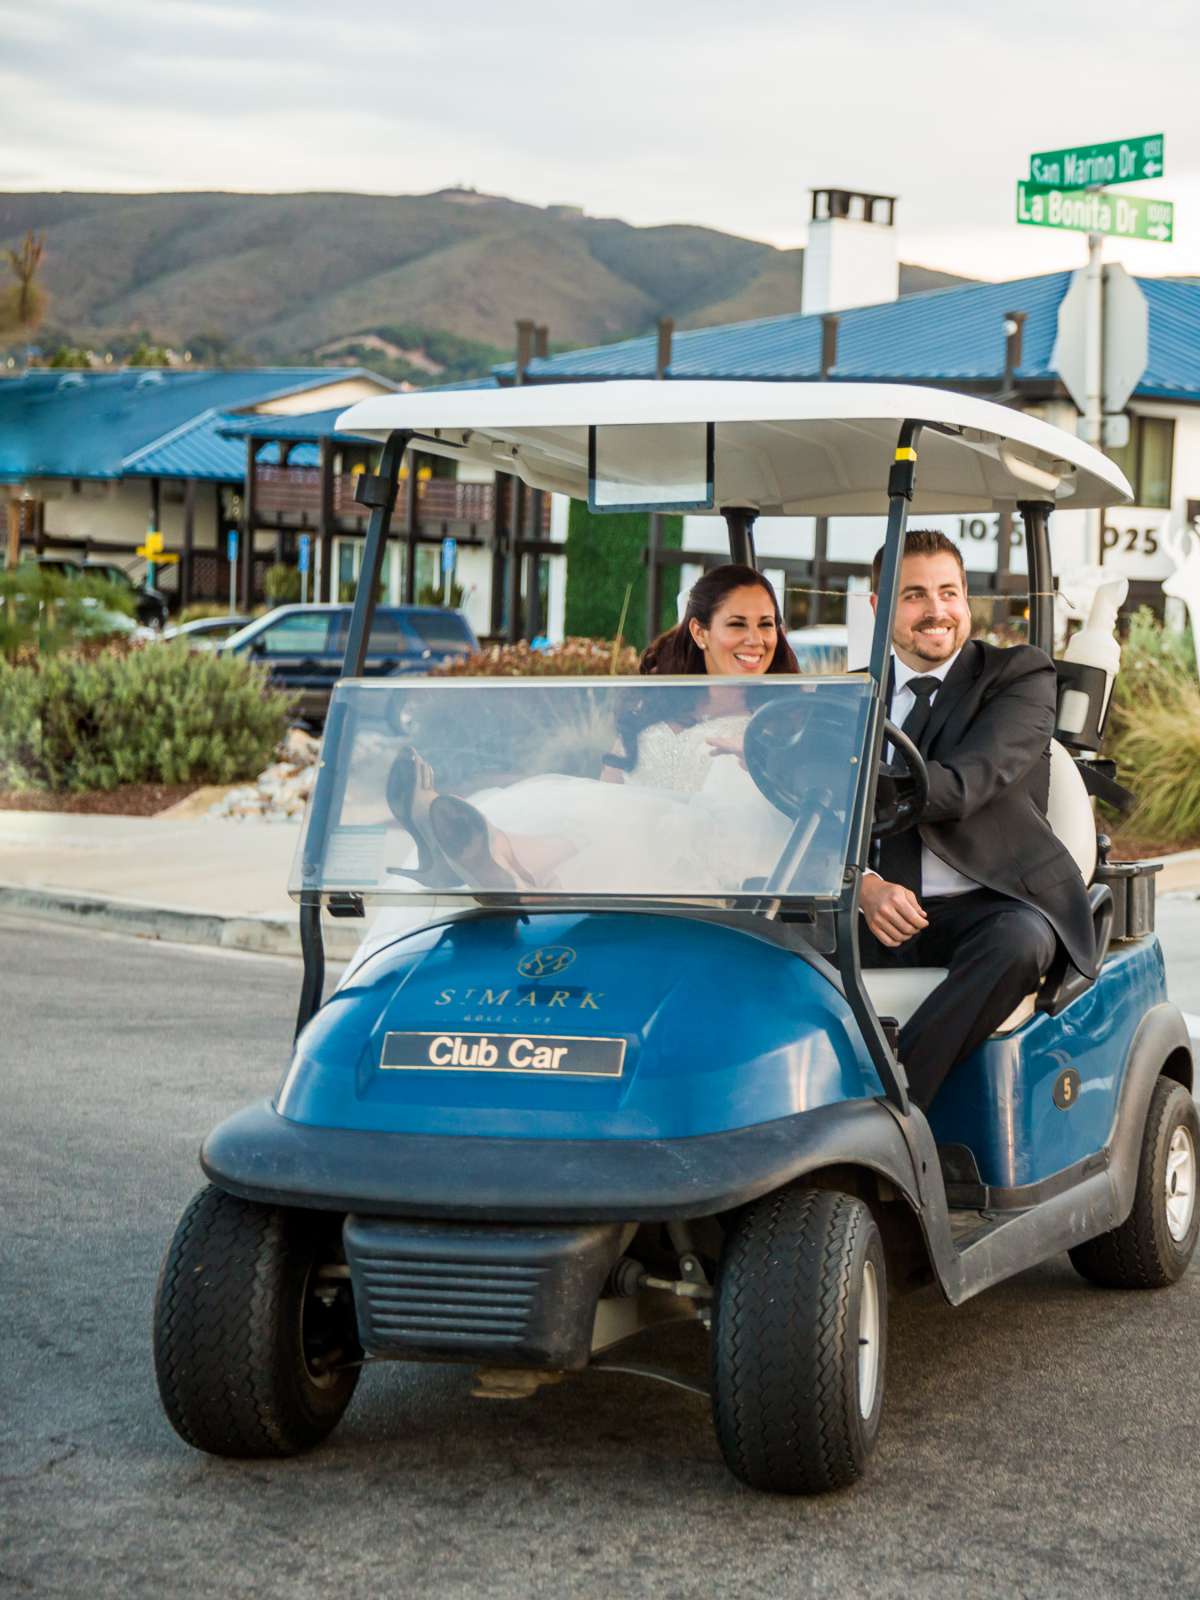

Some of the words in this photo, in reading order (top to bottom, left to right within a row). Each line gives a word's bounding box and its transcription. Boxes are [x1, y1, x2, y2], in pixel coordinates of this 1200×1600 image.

[1032, 157, 1060, 184] San
[1064, 149, 1116, 185] Marino
[1119, 144, 1138, 178] Dr
[1018, 185, 1044, 222] La
[1047, 190, 1112, 232] Bonita
[1116, 199, 1139, 233] Dr
[428, 1036, 498, 1067] Club
[507, 1039, 568, 1069] Car
[1063, 1077, 1072, 1101] 5
